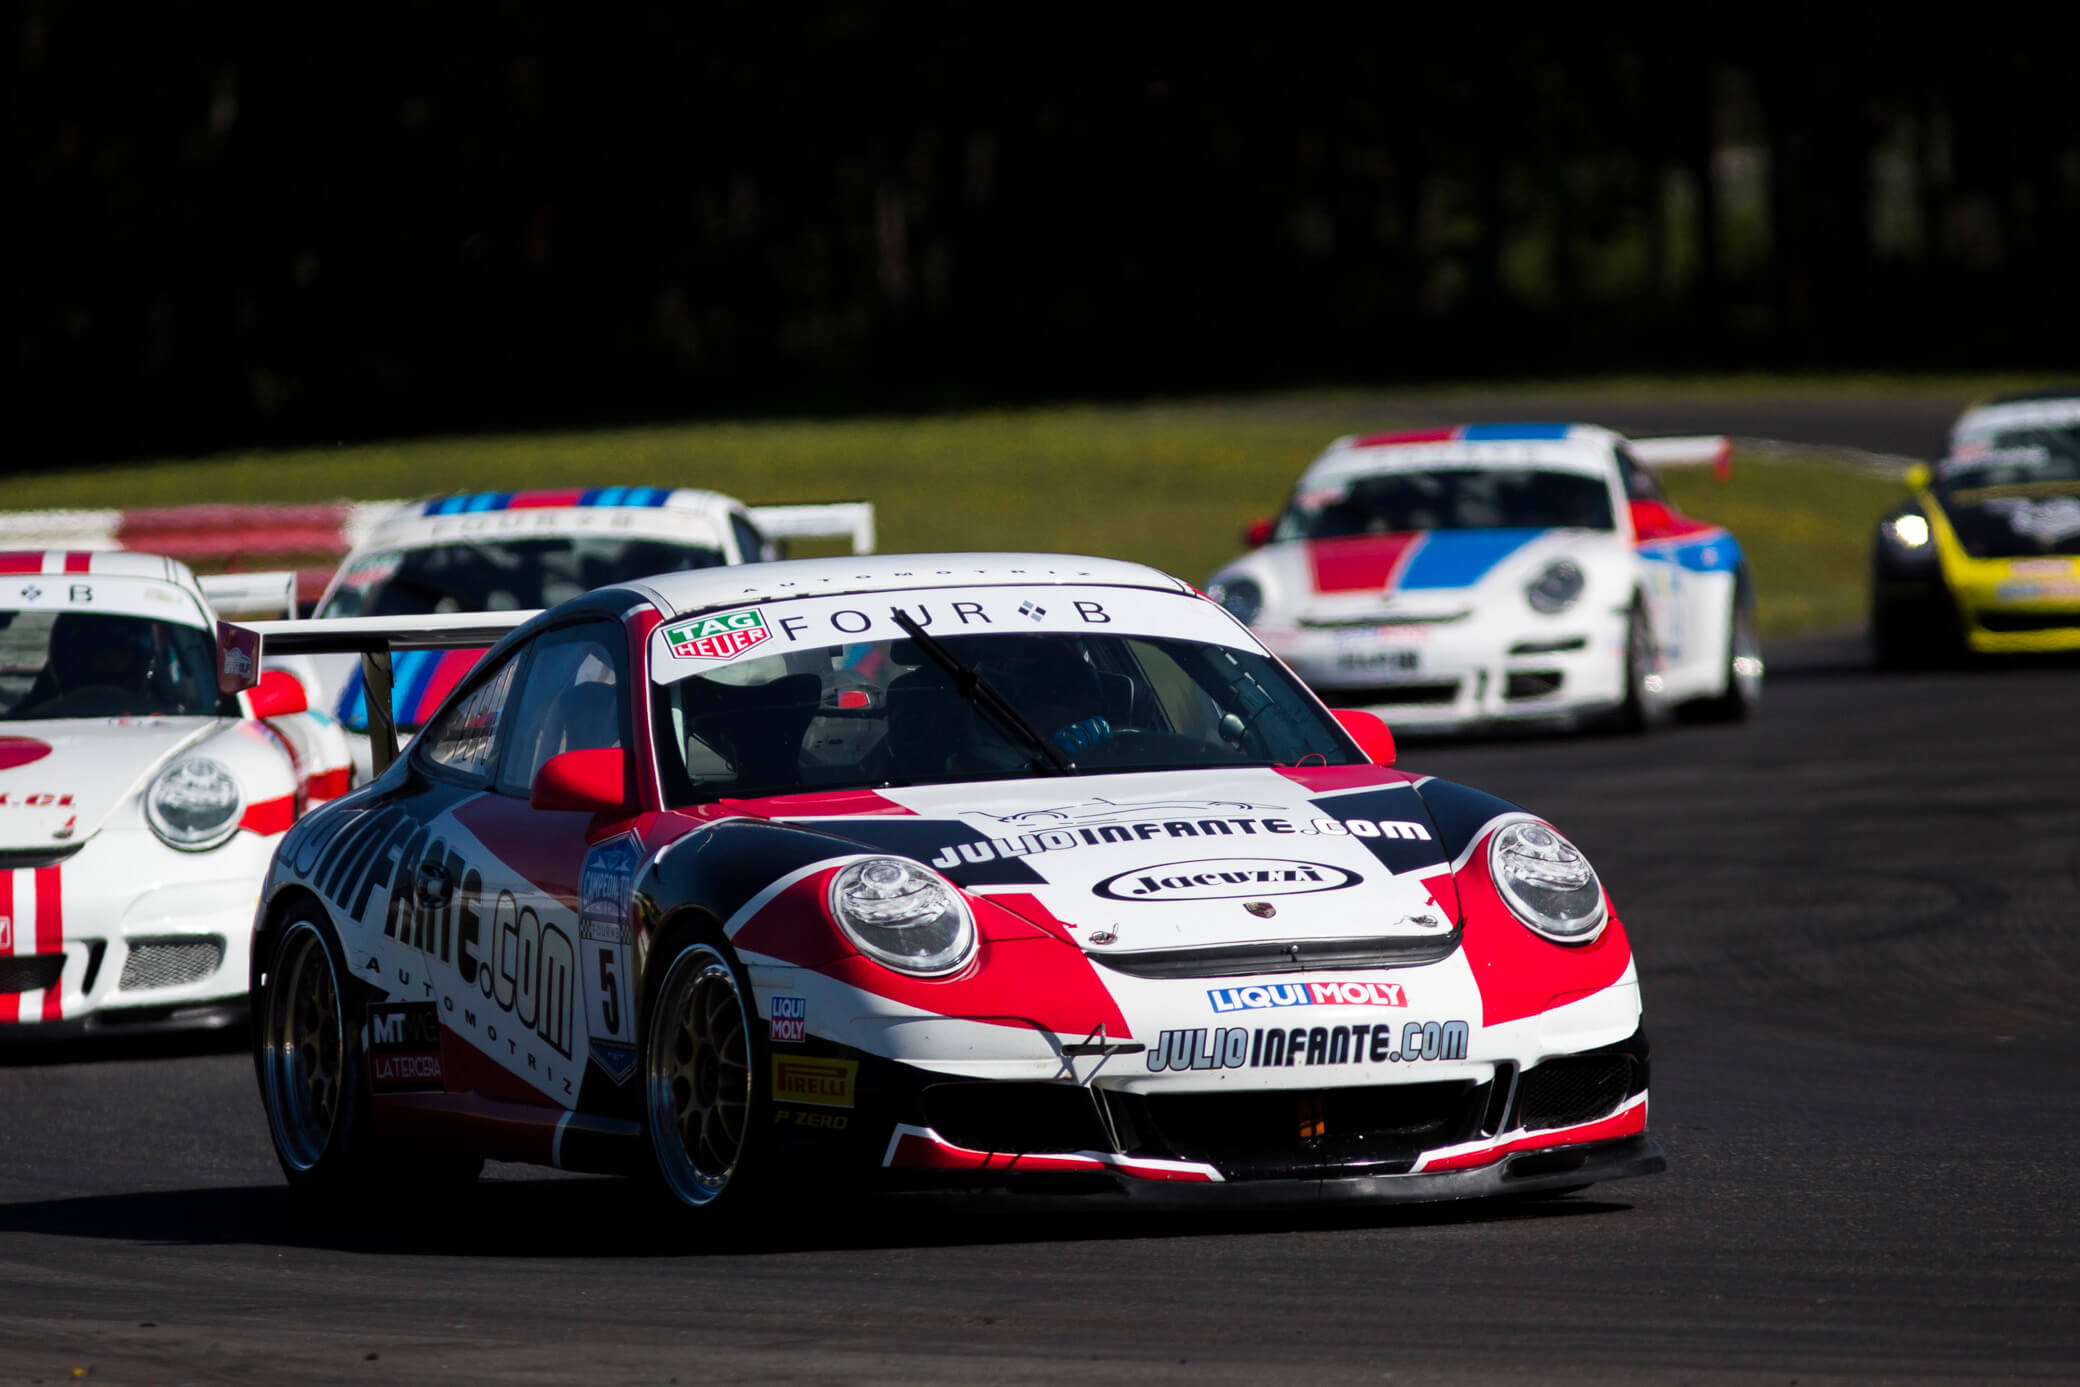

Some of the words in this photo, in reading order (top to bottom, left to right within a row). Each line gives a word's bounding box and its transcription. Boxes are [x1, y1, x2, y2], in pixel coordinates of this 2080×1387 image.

[68, 584, 94, 603] B
[743, 569, 1091, 593] AUTOMOTRIZ
[671, 610, 758, 641] TAG
[1072, 600, 1112, 624] B
[677, 628, 766, 658] HEUER
[1132, 863, 1325, 896] Jacuzzi
[599, 948, 621, 1036] 5
[1212, 984, 1309, 1011] LIQUI
[1313, 983, 1403, 1007] MOLY
[772, 998, 805, 1019] LIQUI
[365, 956, 573, 1096] AUTOMOTRIZ
[770, 1019, 806, 1040] MOLY
[777, 1061, 849, 1097] PIRELLI
[775, 1110, 790, 1124] P
[794, 1112, 849, 1129] ZERO
